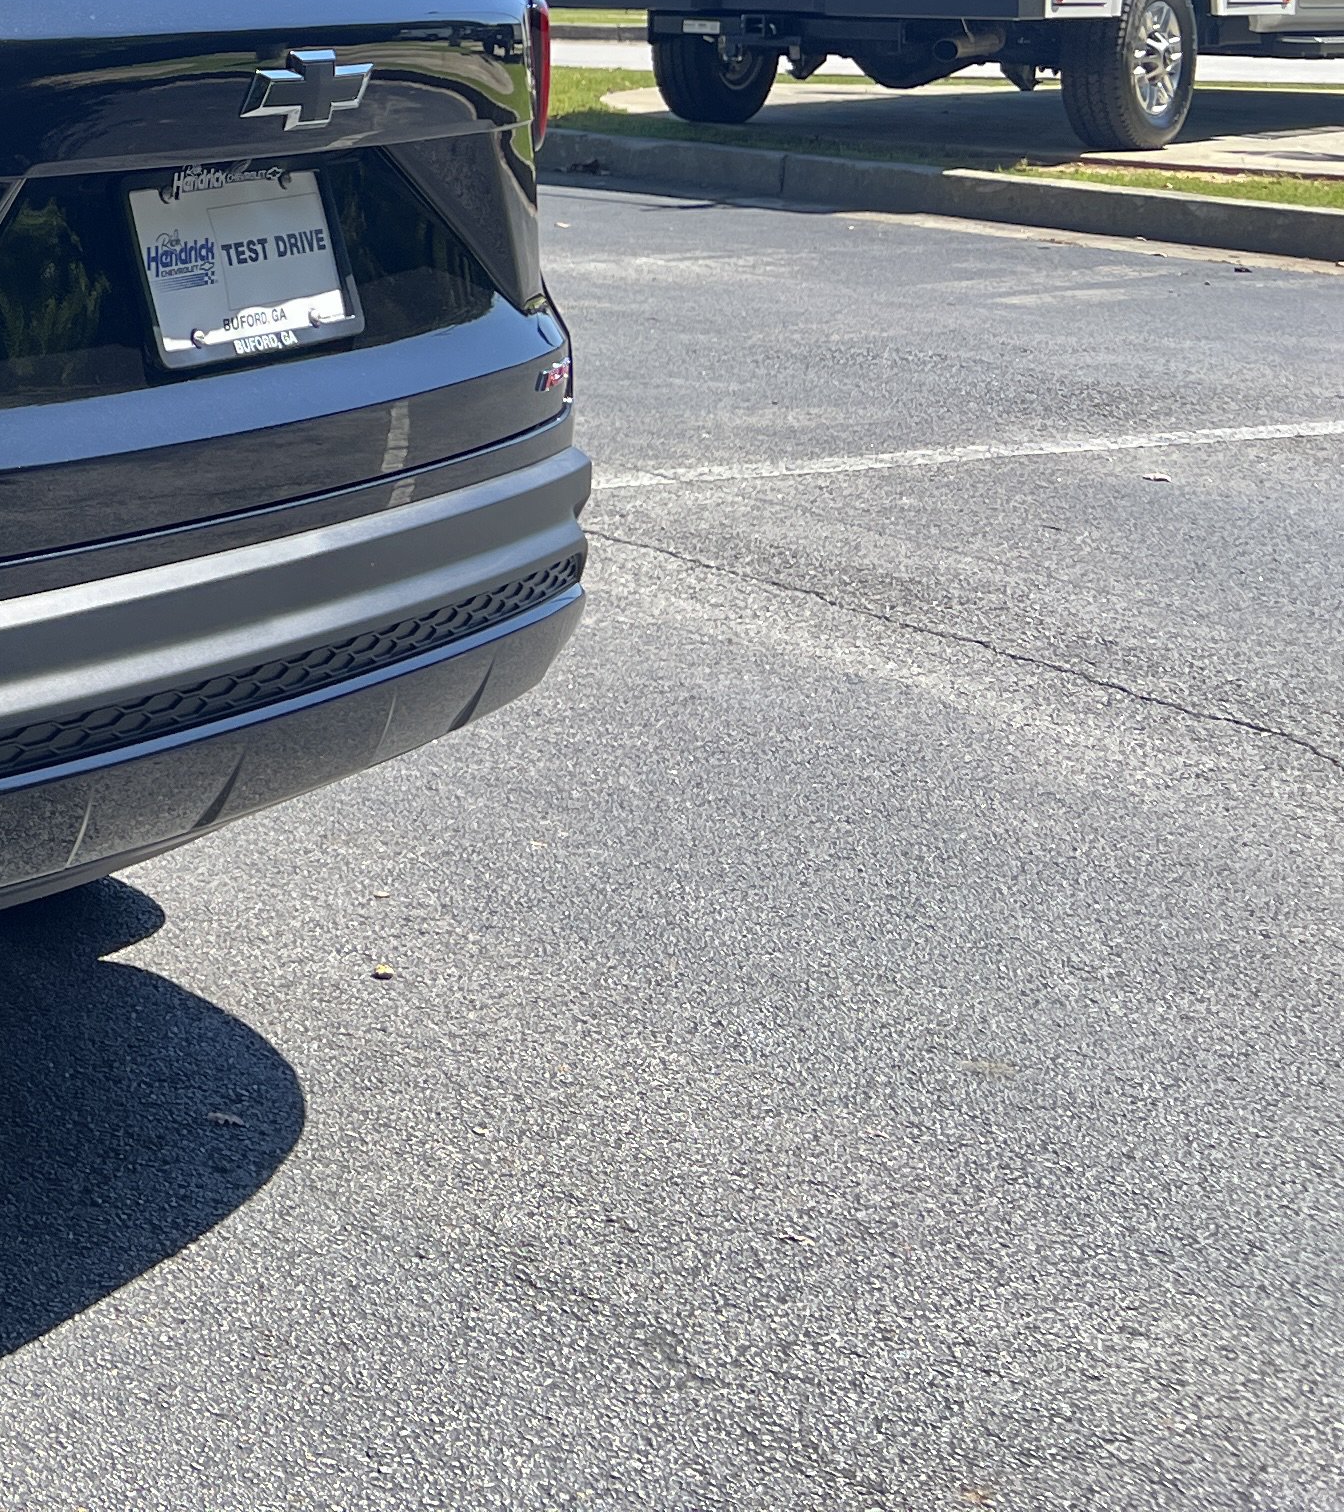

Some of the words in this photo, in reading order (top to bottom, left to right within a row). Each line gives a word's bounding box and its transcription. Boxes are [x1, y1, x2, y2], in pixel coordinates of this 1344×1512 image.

[172, 168, 227, 200] Hendrick
[146, 237, 216, 278] Hendrick
[221, 238, 269, 267] TEST
[275, 228, 327, 259] DRIVE
[271, 307, 288, 323] GA
[233, 333, 283, 355] BUFORD,
[280, 330, 299, 346] GA
